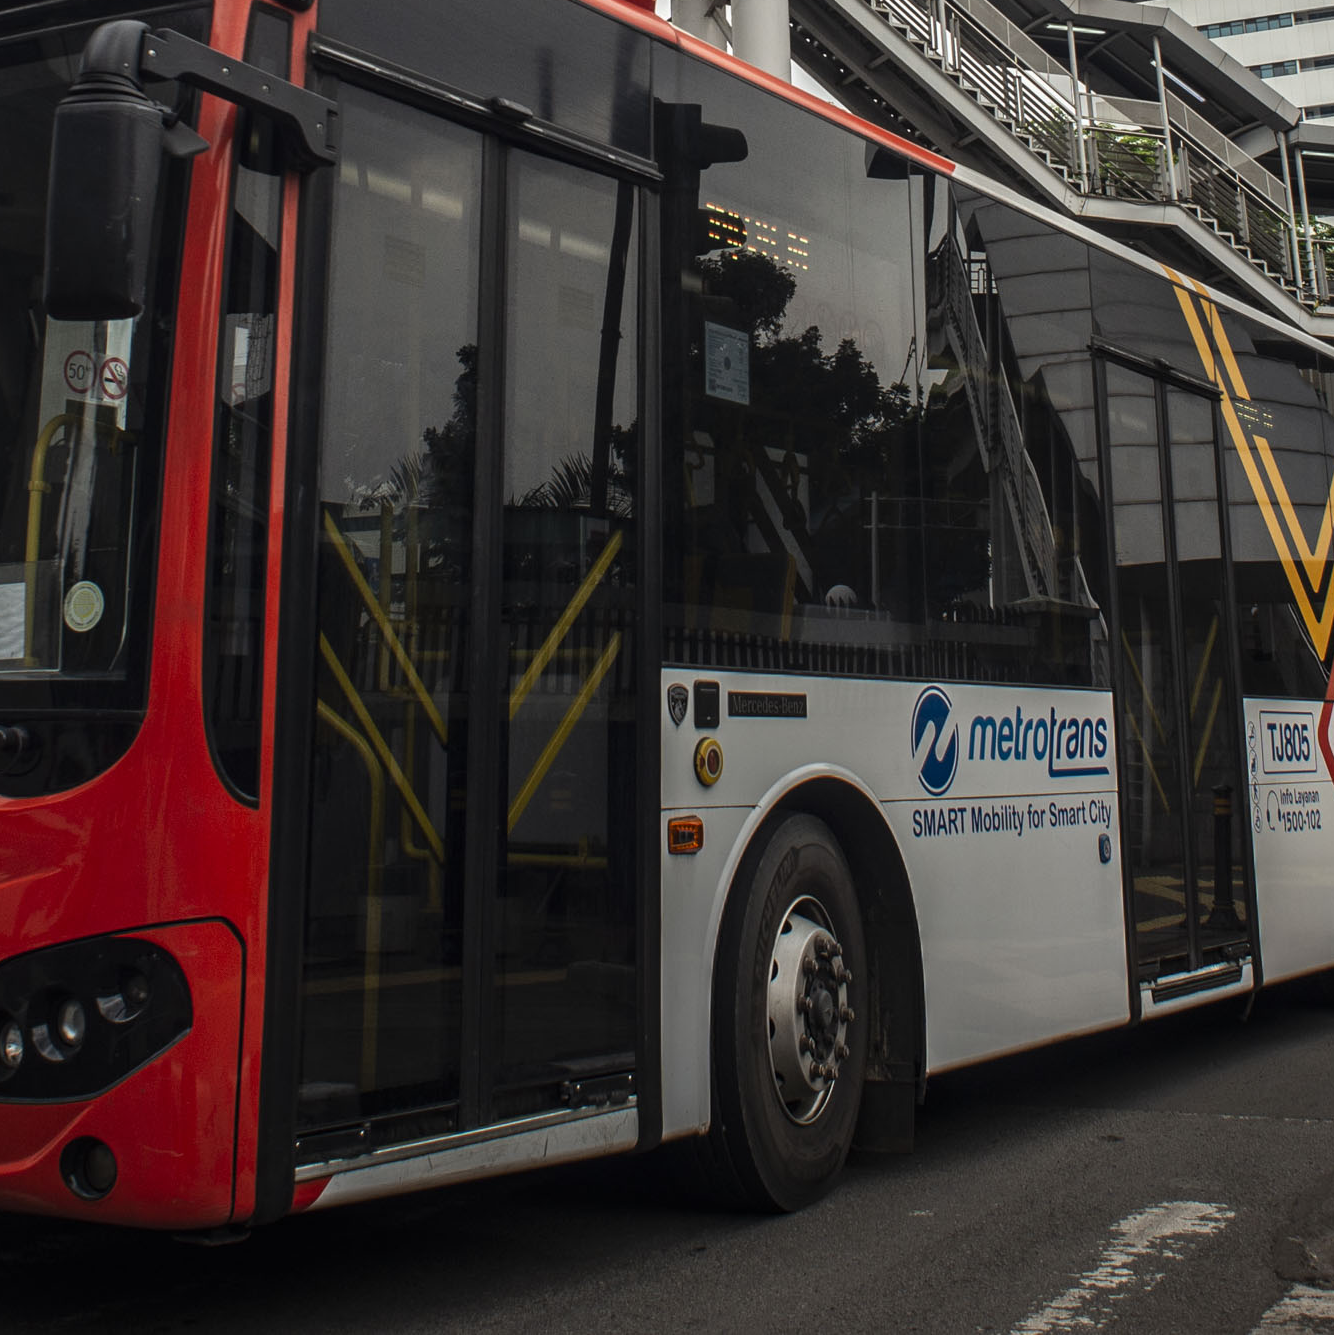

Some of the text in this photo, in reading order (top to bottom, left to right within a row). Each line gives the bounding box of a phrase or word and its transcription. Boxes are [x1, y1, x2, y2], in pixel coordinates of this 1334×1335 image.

[732, 695, 804, 714] Mercedes-Benz
[968, 705, 1110, 778] metrotrans
[1267, 722, 1311, 762] TJ805
[1280, 788, 1320, 807] Info Layanan
[913, 799, 1112, 837] SMART Mobility for Smart City
[1281, 809, 1322, 833] 1500-102
